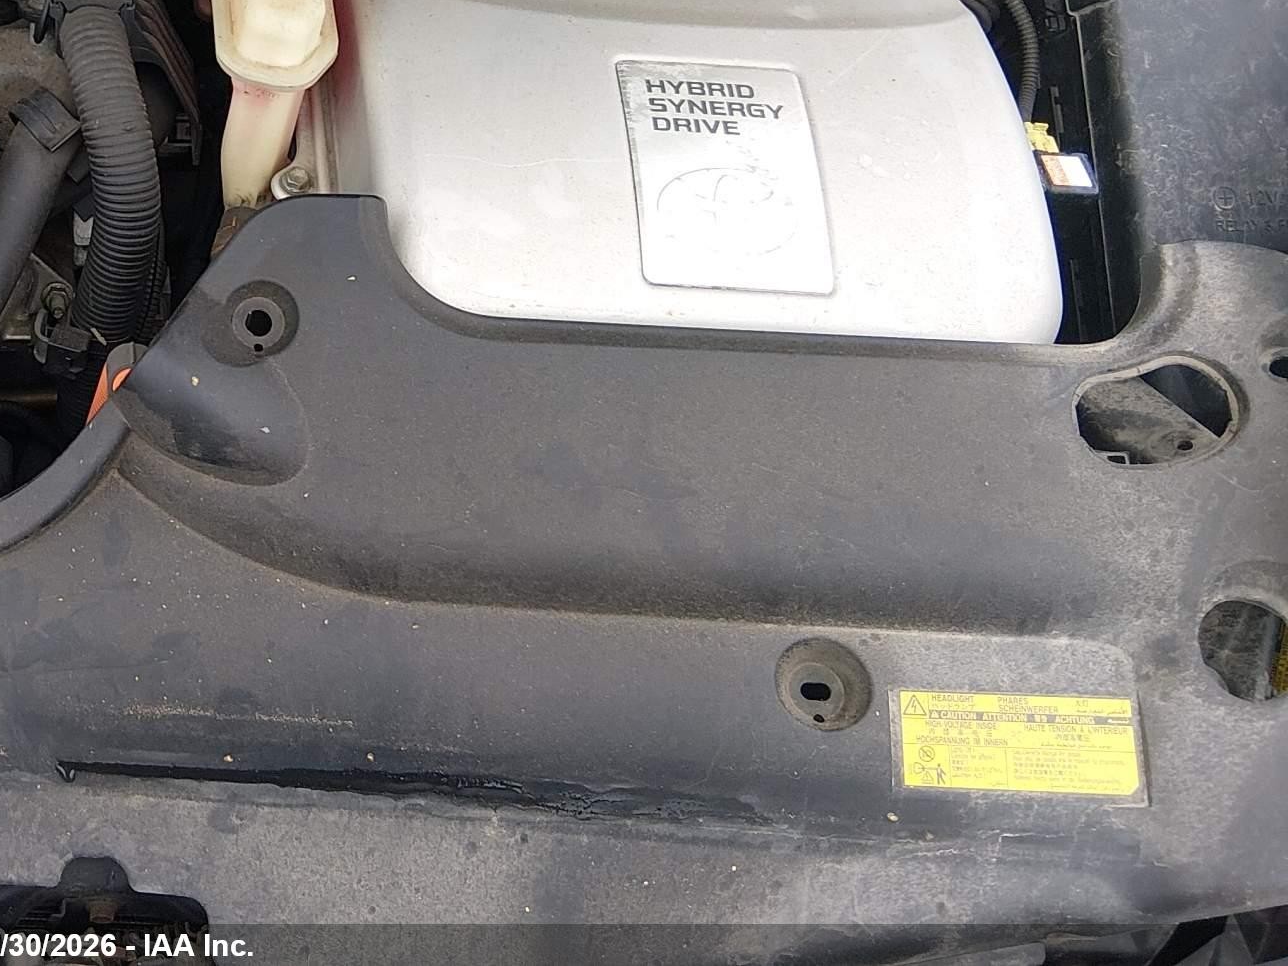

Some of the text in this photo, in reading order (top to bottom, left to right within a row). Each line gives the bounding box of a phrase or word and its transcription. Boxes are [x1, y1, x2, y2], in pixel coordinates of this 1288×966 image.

[645, 79, 754, 99] HYBRID
[648, 98, 783, 119] SYNERGY
[652, 117, 740, 135] DRIVE
[932, 694, 974, 702] HEADLIGHT
[998, 696, 1029, 704] PHARES
[999, 704, 1059, 713] SCHEINWERFER
[940, 711, 976, 720] CAUTION
[982, 712, 1026, 722] ATTENTION
[1055, 714, 1095, 724] ACHTUNG
